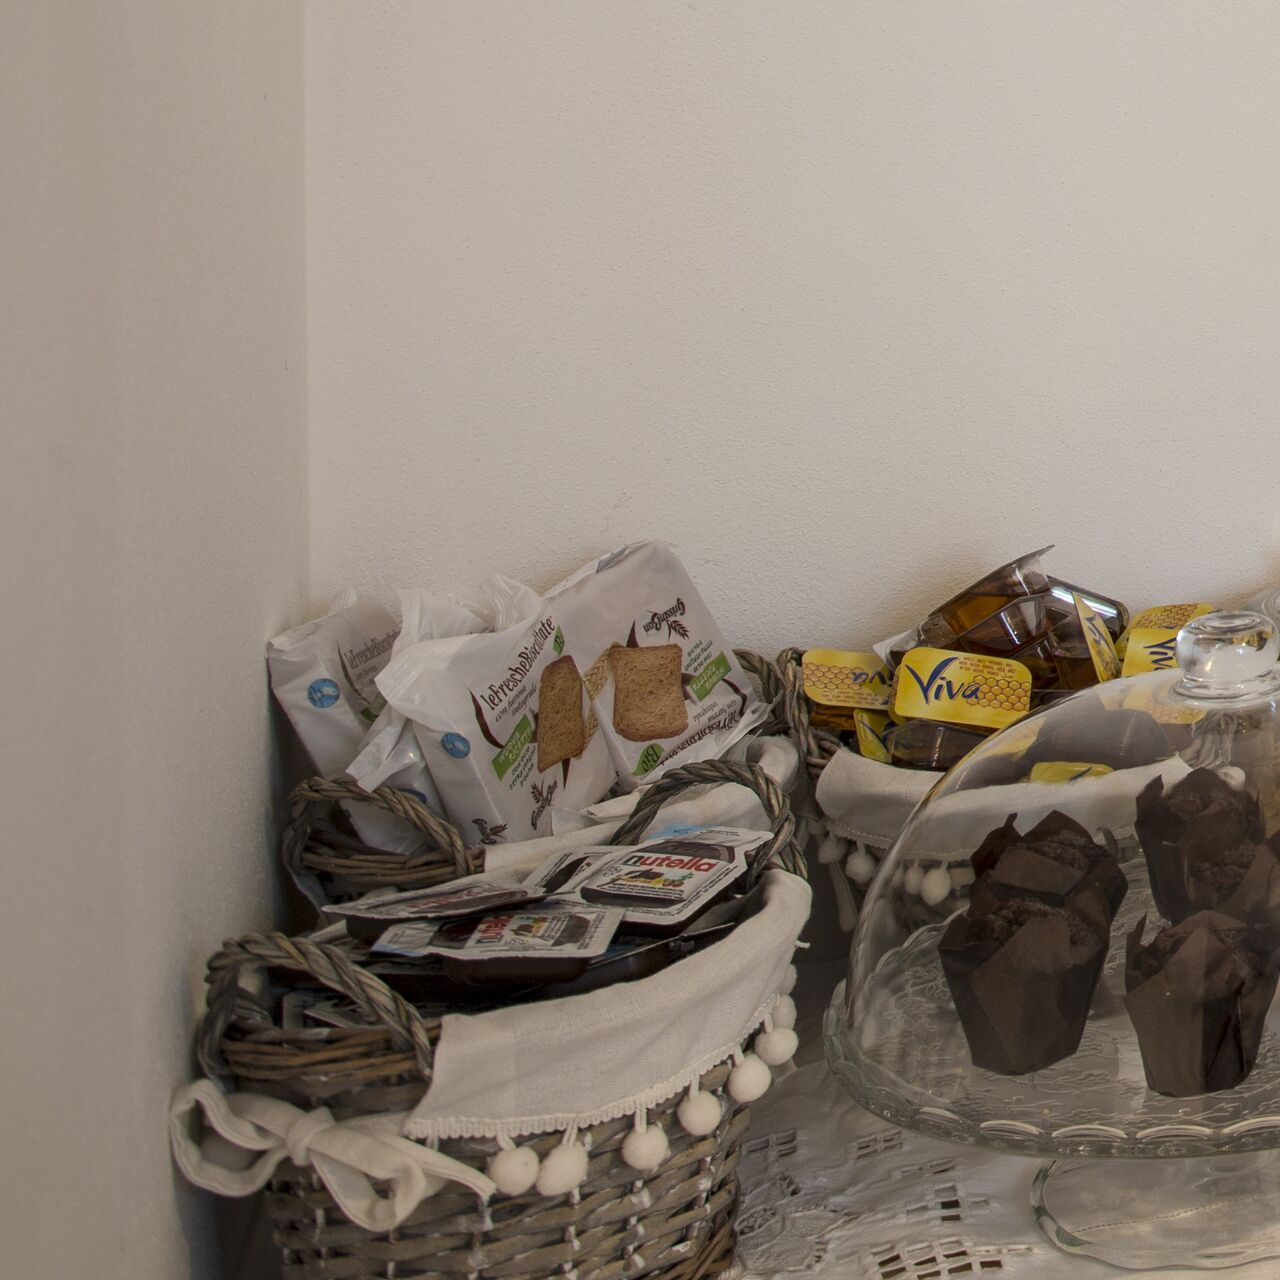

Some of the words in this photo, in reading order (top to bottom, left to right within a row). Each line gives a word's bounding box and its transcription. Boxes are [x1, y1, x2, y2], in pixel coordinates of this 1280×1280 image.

[643, 598, 686, 633] GrissinBon
[480, 616, 555, 711] leFrescheBiscottate
[904, 656, 982, 705] Viva
[642, 744, 661, 773] Bio
[622, 854, 719, 873] nutella
